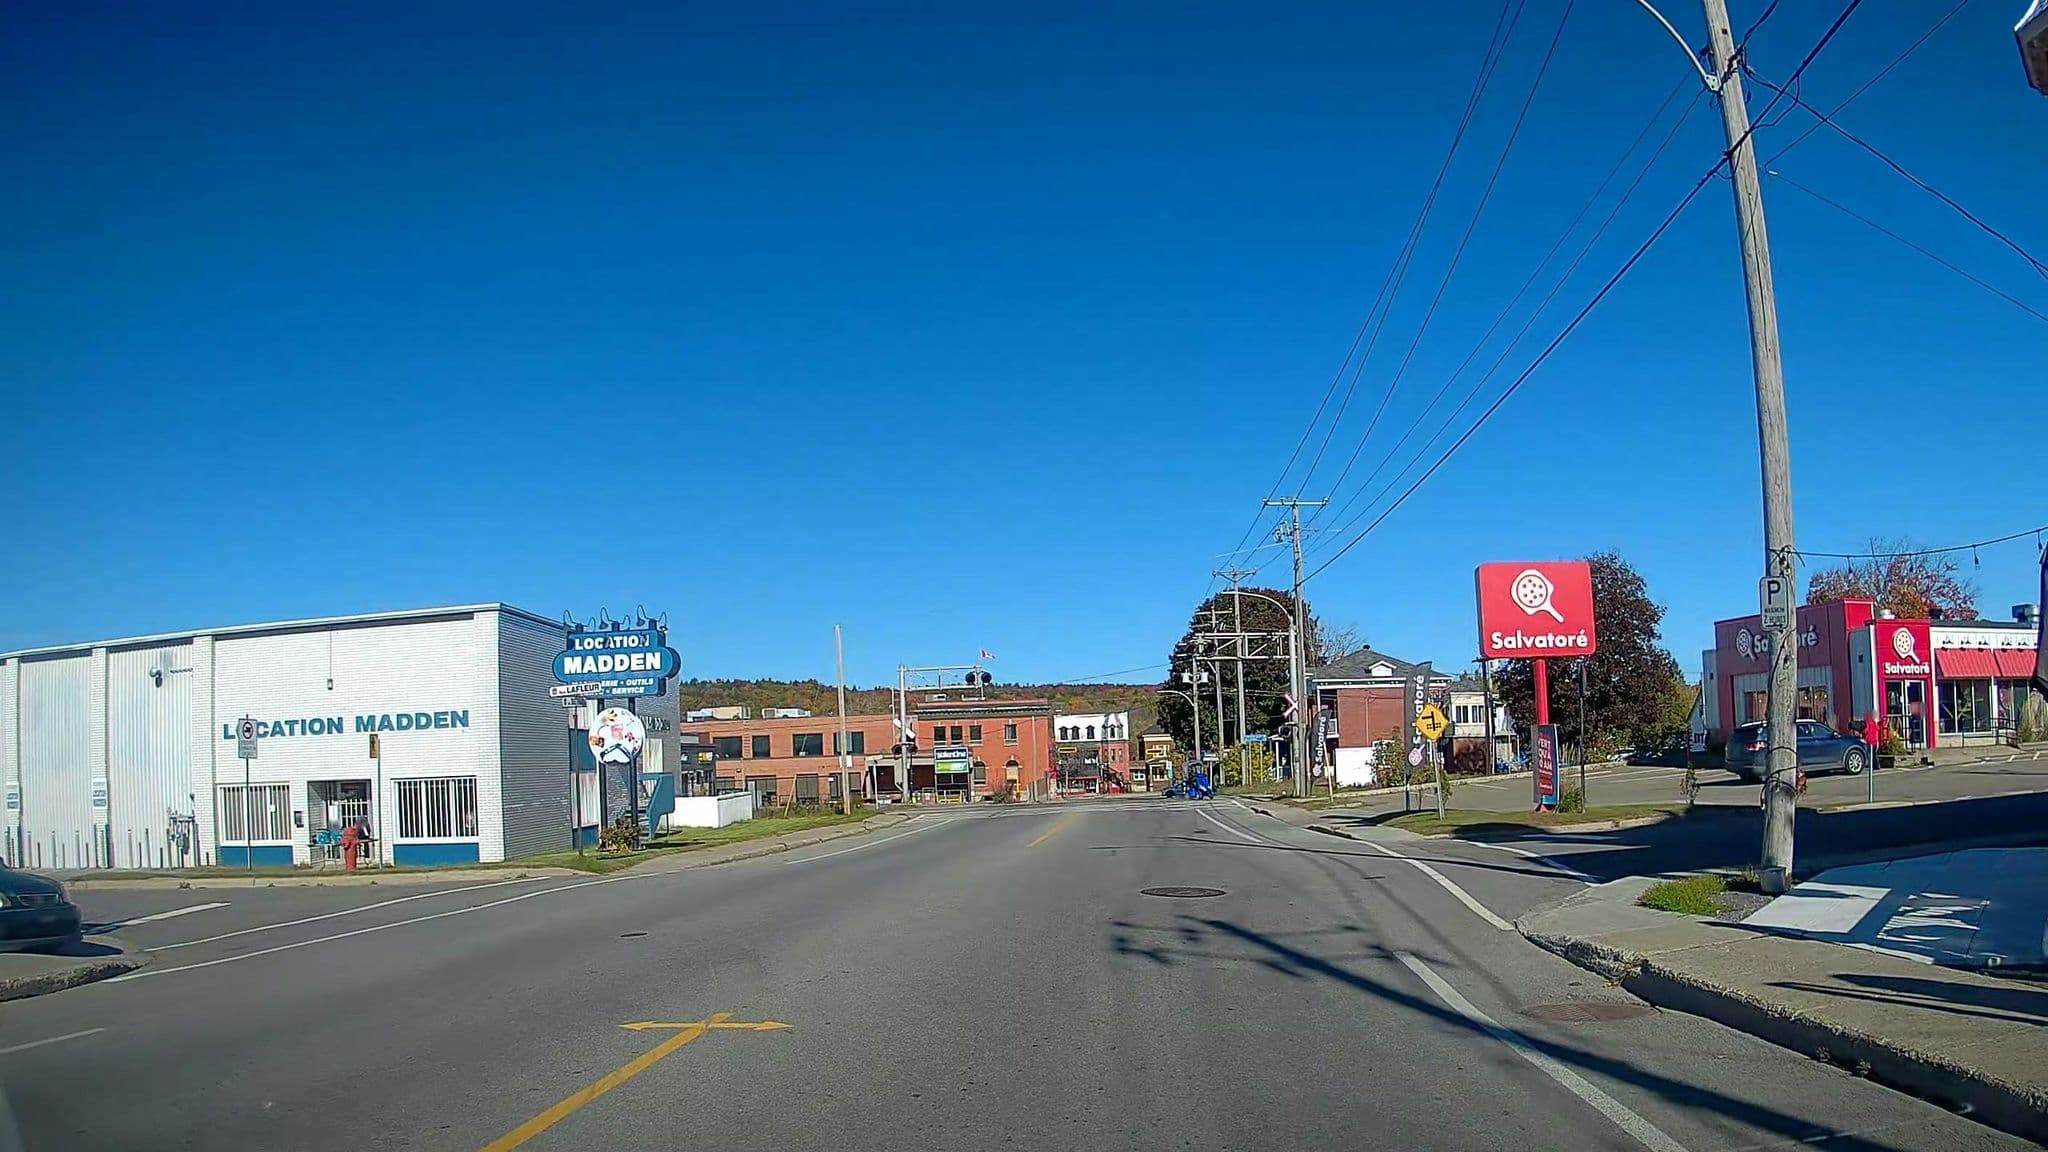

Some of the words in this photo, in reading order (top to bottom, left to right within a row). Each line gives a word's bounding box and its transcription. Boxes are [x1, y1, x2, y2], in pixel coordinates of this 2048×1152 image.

[1767, 580, 1781, 605] P
[575, 634, 650, 650] LOCATION
[1491, 629, 1588, 649] Salvatoré
[564, 652, 661, 675] MADDEN
[1884, 662, 1930, 674] Salvatoré
[566, 683, 600, 694] LAFLEUR
[611, 686, 645, 695] SERVICE
[626, 678, 654, 686] OUTILS
[1412, 675, 1425, 745] Saatoré
[223, 717, 344, 739] LCATION
[355, 710, 469, 732] MADDEN
[1315, 716, 1327, 762] Salvatoré
